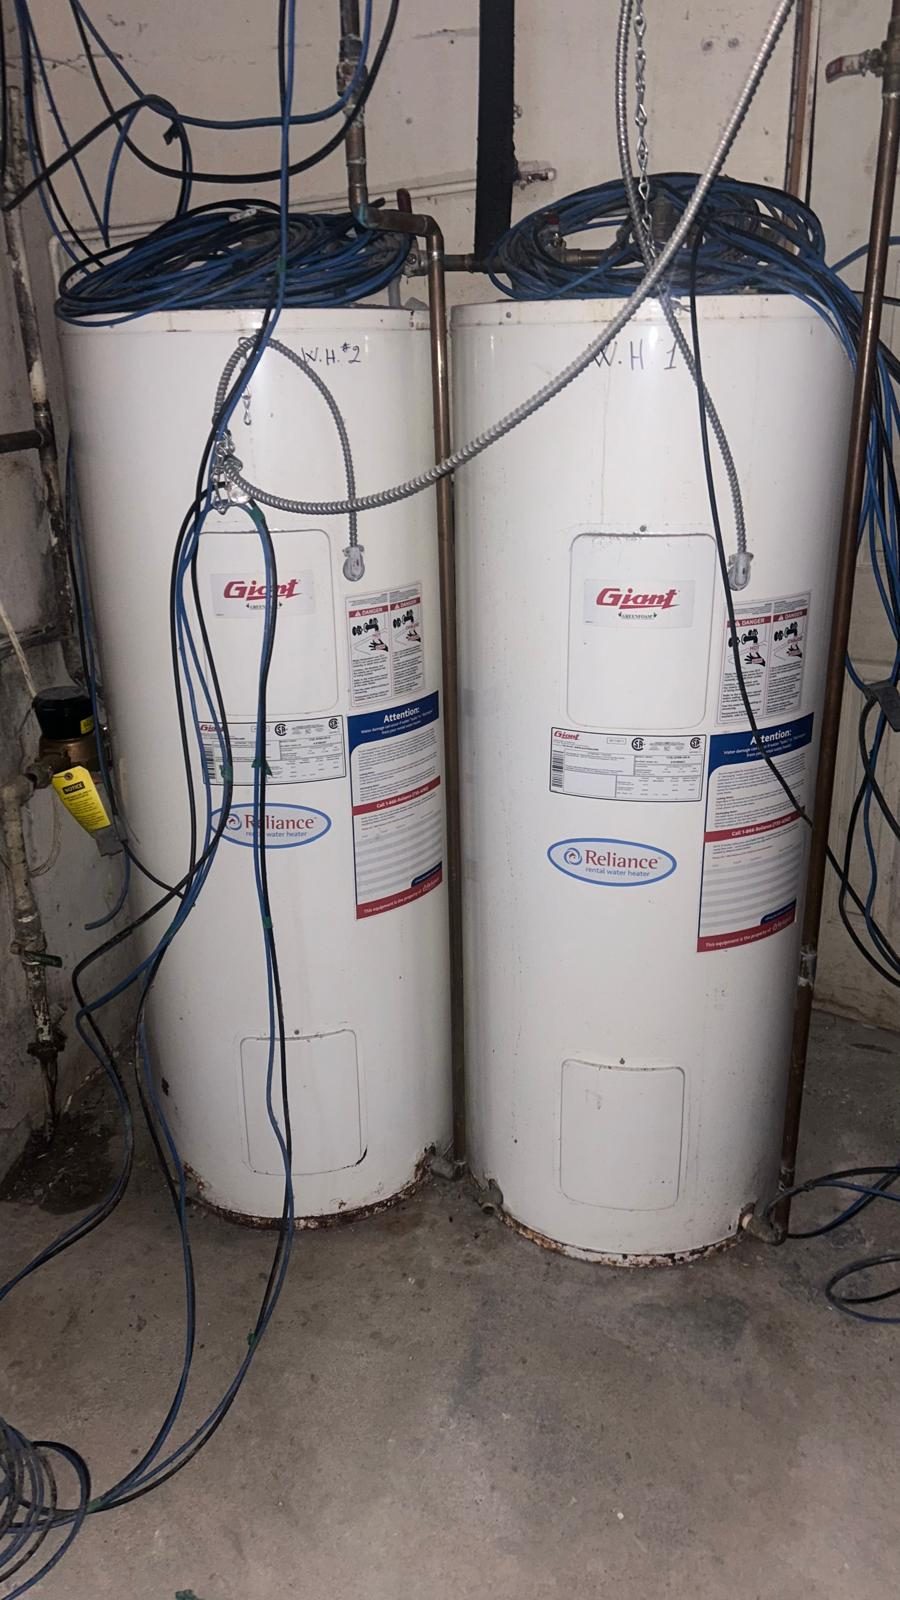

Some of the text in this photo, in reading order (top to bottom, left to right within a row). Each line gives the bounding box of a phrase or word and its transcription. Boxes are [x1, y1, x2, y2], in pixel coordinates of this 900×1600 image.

[596, 588, 681, 609] Giant
[741, 617, 765, 626] DANGER
[383, 706, 420, 723] Attention:
[554, 730, 580, 741] Giant
[750, 729, 792, 746] Atention:
[244, 814, 315, 830] Rliance
[585, 849, 658, 869] Reliance
[585, 866, 606, 874] rental
[628, 869, 650, 877] heater
